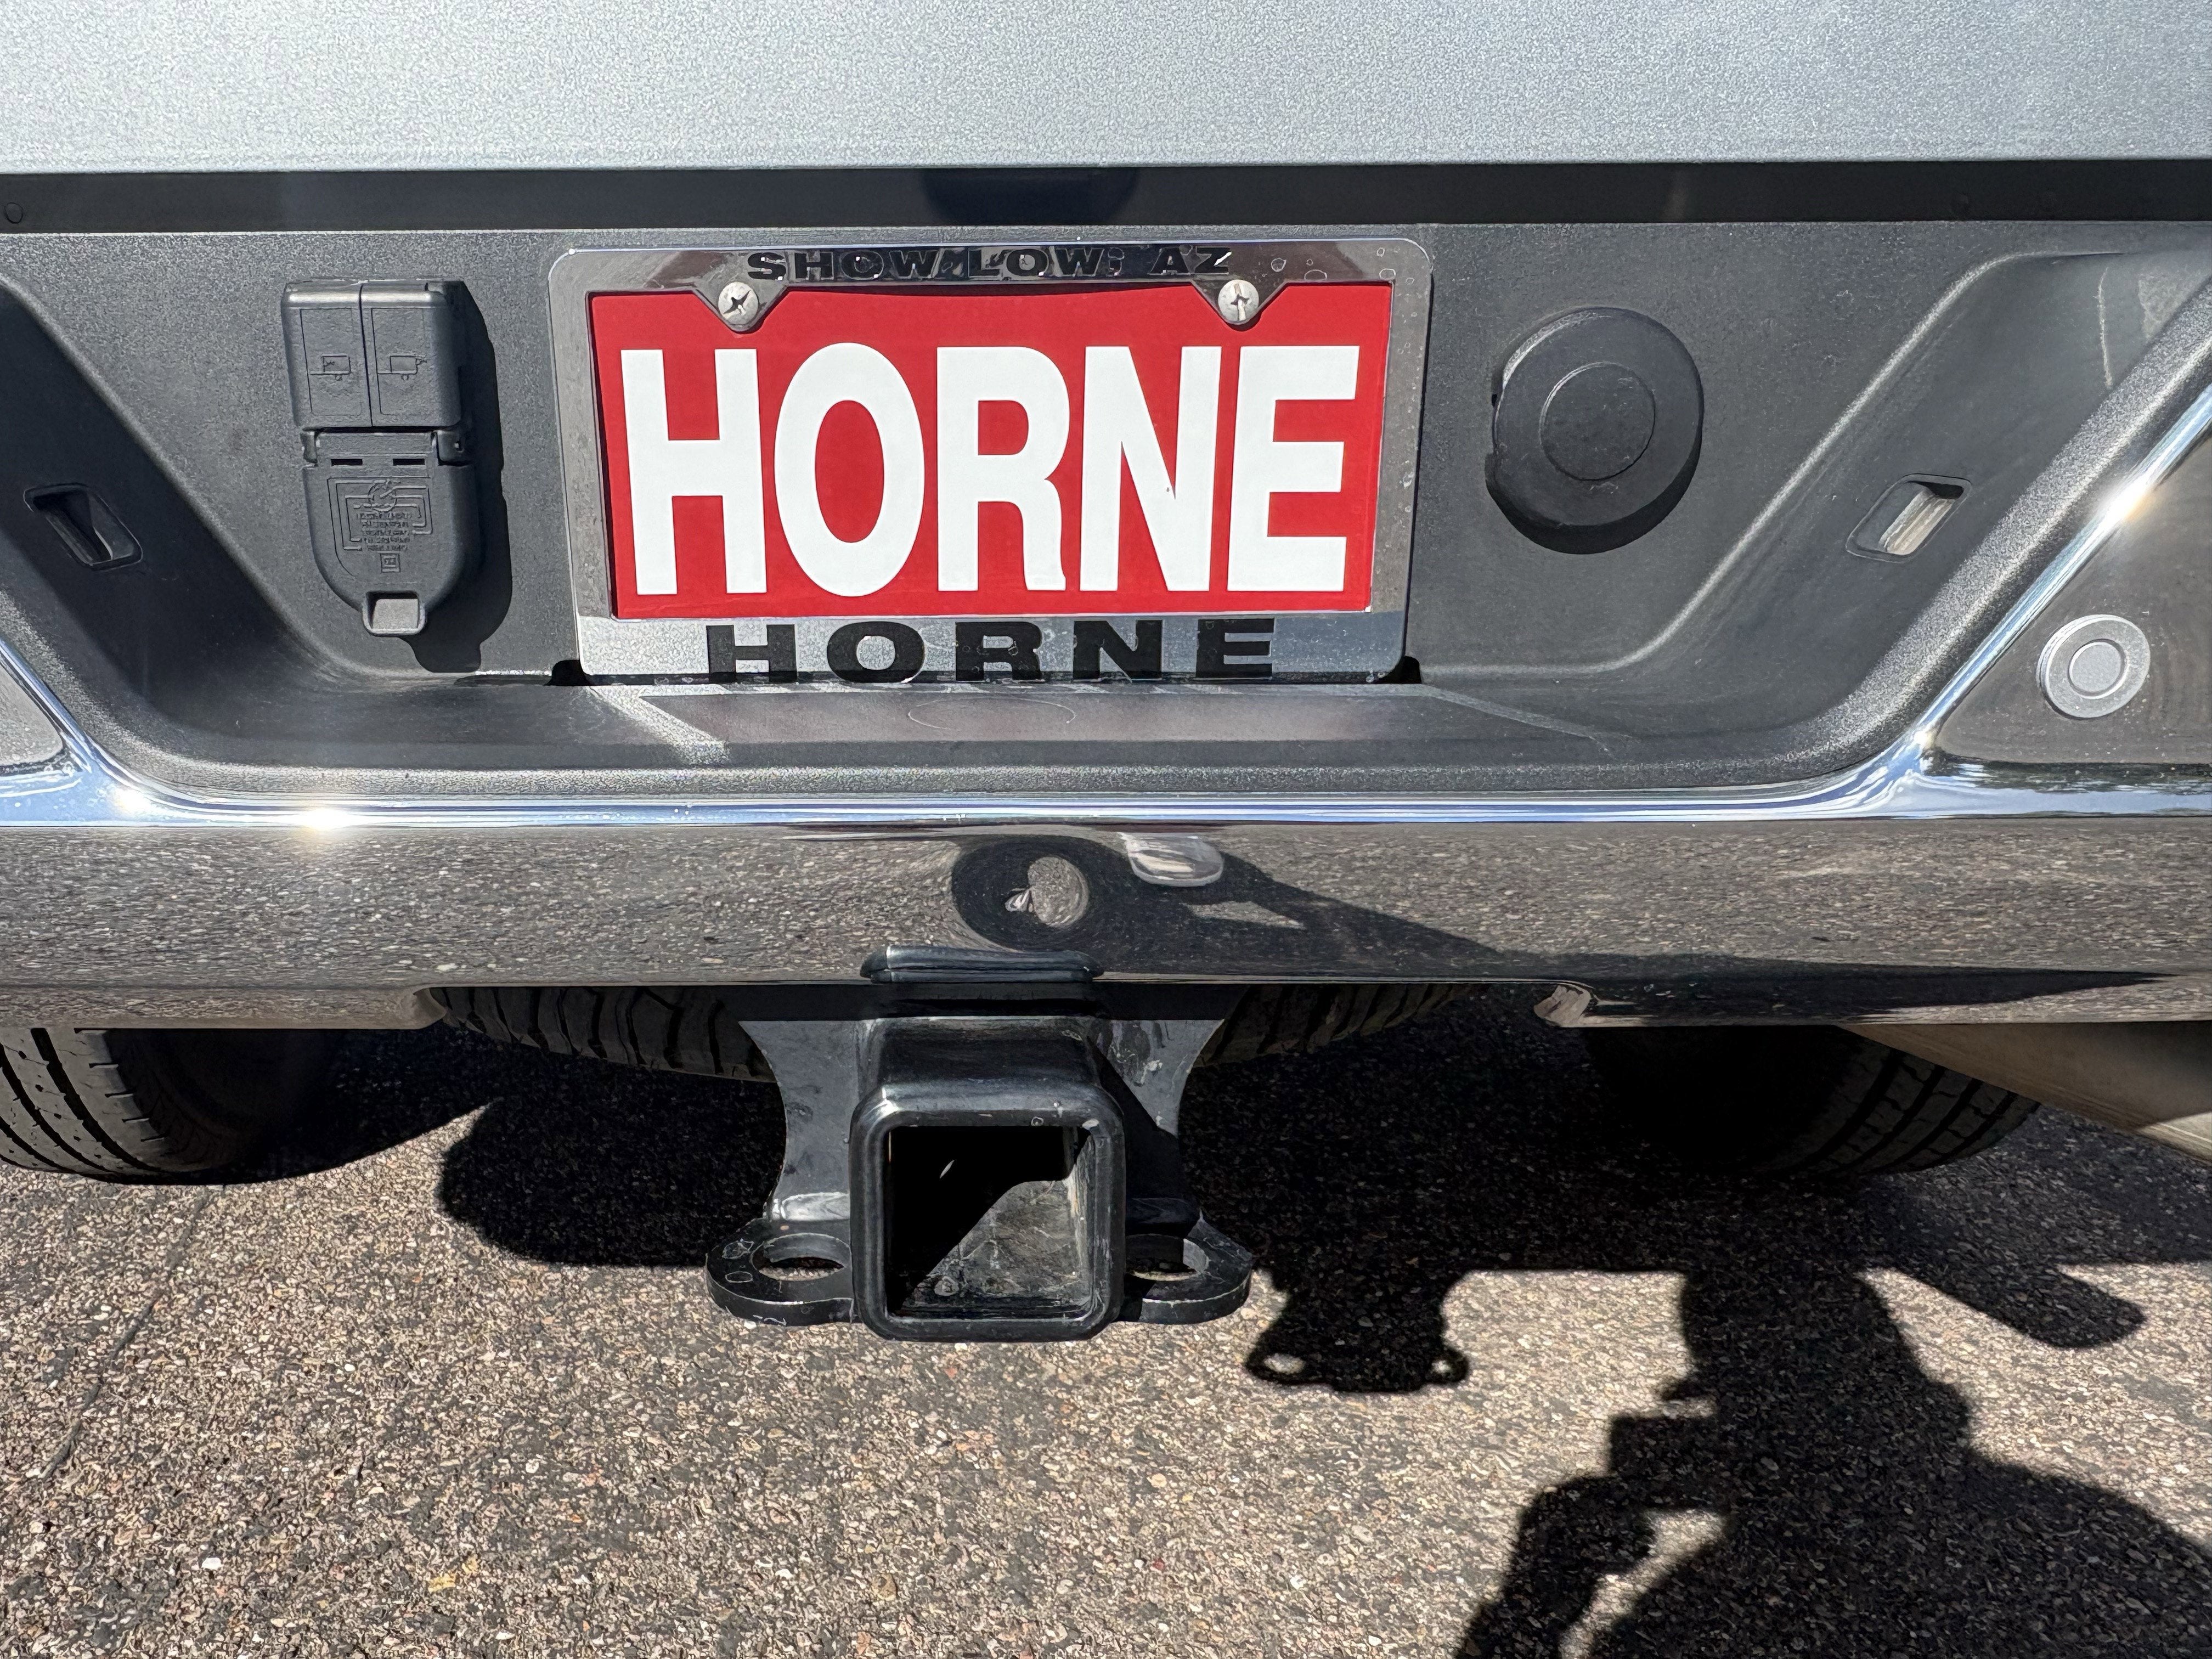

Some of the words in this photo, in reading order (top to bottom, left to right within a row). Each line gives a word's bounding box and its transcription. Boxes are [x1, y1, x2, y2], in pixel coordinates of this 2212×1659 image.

[747, 250, 945, 280] SHOW
[1147, 245, 1232, 275] AZ
[621, 343, 1360, 596] HORNE
[706, 618, 1275, 684] HORNE
